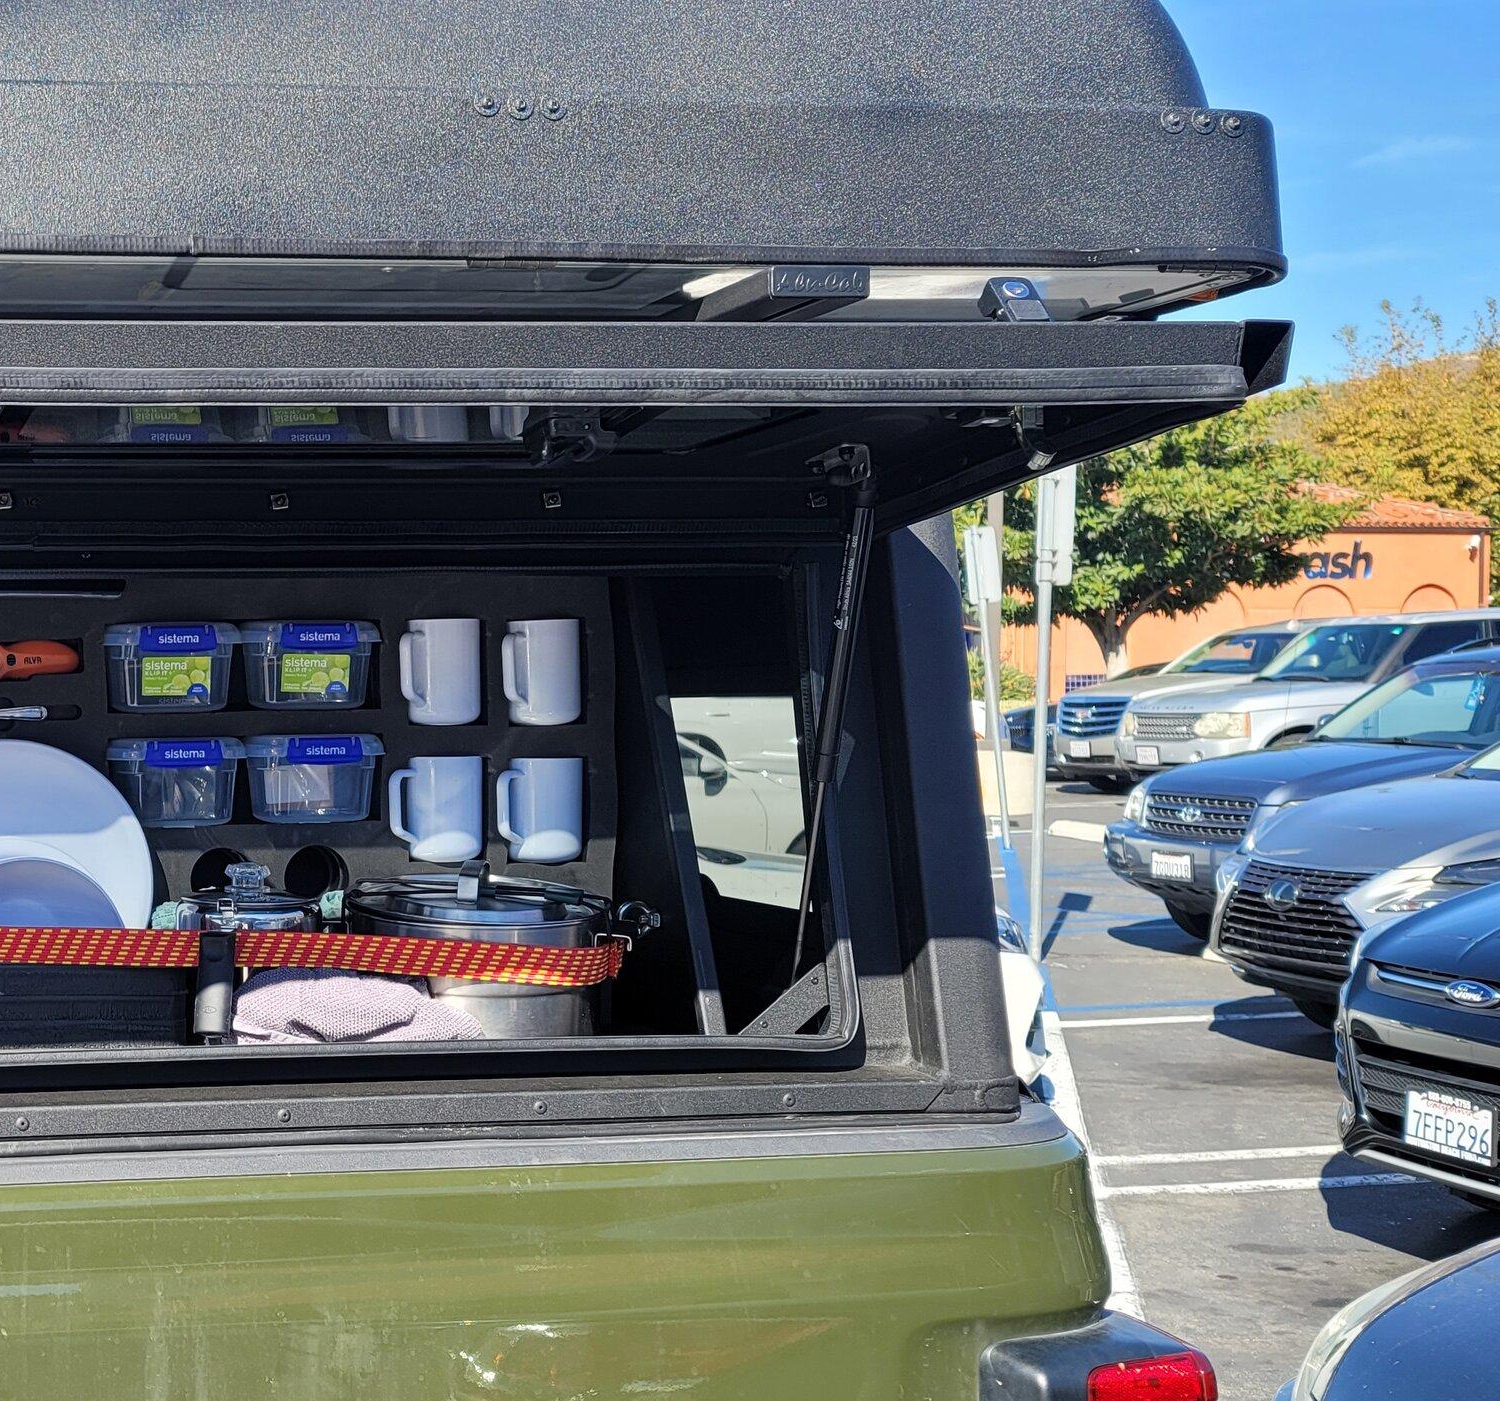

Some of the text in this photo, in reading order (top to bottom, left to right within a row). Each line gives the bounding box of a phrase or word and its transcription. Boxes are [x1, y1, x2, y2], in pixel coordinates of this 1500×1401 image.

[776, 271, 866, 293] Alu-Cab
[1301, 540, 1373, 579] ash
[158, 633, 200, 644] sistema
[299, 631, 341, 642] sistema
[23, 656, 42, 665] ALVA
[144, 660, 187, 670] sistema
[285, 657, 327, 668] sistema
[164, 748, 206, 759] sistema
[306, 745, 346, 756] sistema
[1451, 983, 1485, 1001] Ford
[1413, 1109, 1489, 1155] 7FFP296
